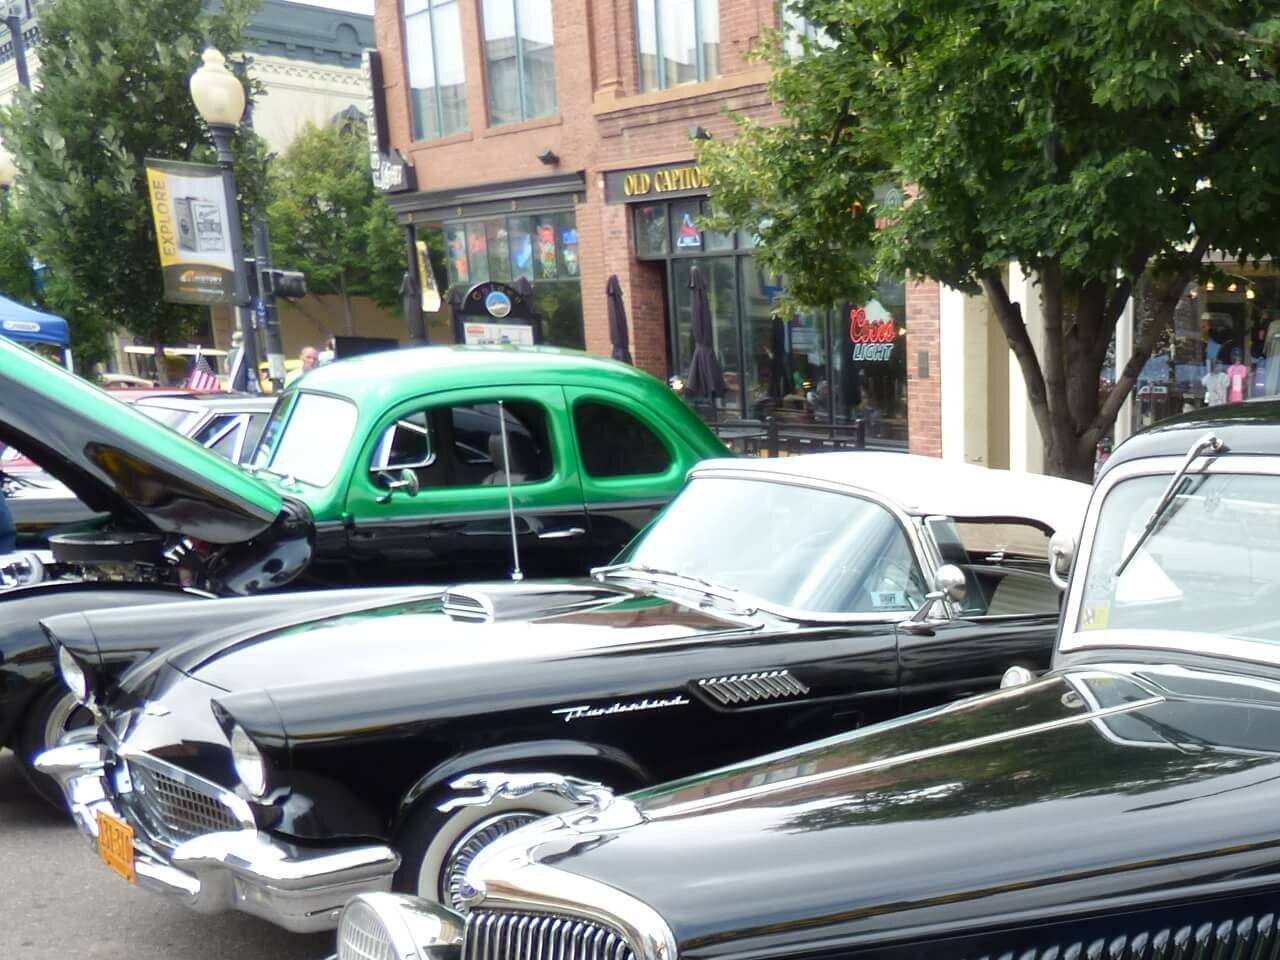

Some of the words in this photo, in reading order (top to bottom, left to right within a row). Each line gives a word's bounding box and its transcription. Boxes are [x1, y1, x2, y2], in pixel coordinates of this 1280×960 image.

[624, 173, 650, 196] OLD
[152, 179, 176, 257] EXPLORE
[852, 343, 895, 361] LIGHT
